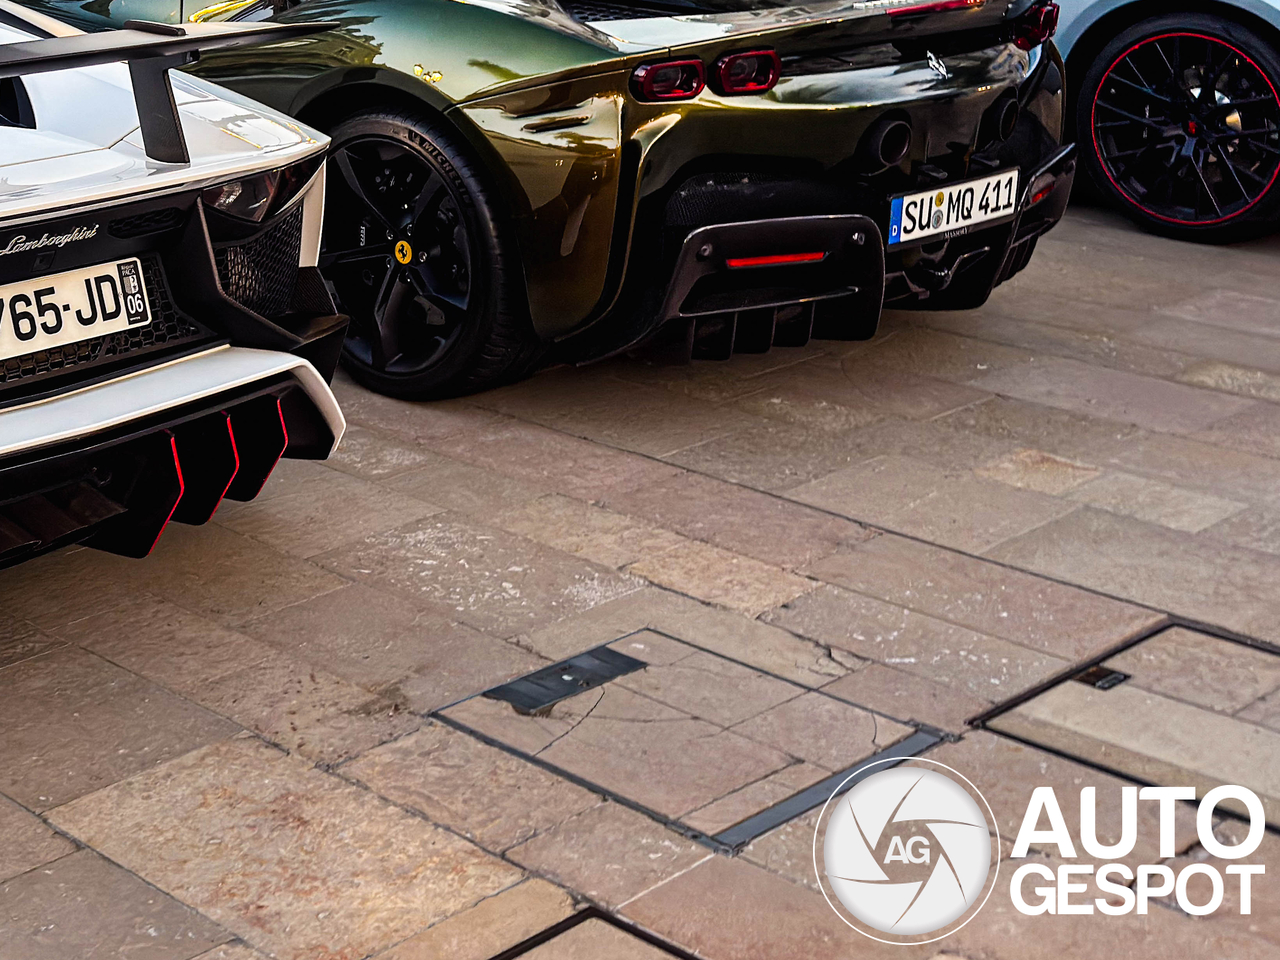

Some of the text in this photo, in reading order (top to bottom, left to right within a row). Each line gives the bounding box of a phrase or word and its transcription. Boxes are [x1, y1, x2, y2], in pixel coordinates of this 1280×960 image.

[902, 176, 1013, 235] SU MQ 411
[891, 225, 898, 237] D
[121, 268, 136, 276] PACA
[127, 293, 144, 314] 06
